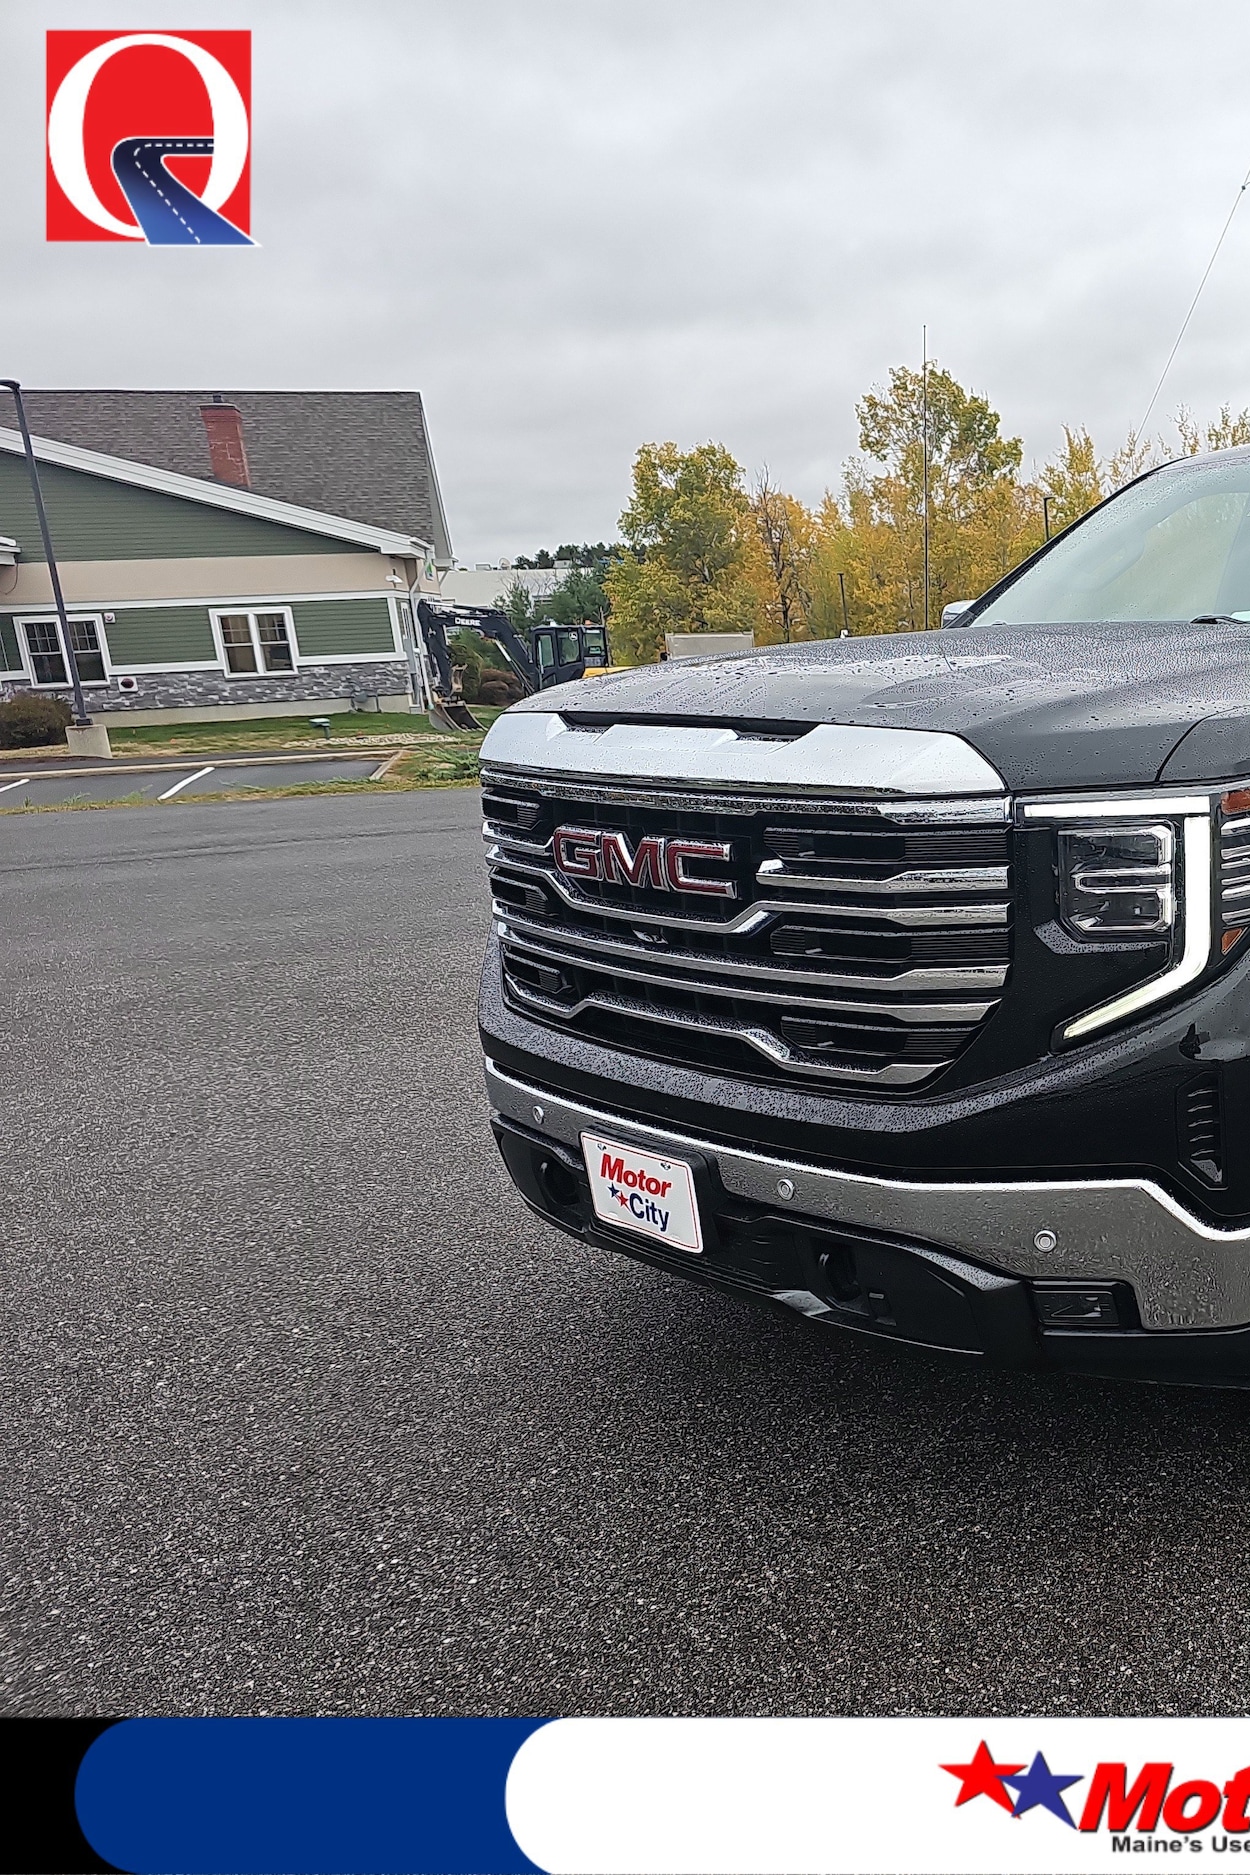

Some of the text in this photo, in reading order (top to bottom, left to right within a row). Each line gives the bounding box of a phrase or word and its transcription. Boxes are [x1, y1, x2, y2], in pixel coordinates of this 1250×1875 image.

[553, 825, 738, 900] GMC
[600, 1153, 672, 1199] Motor
[629, 1192, 670, 1232] City
